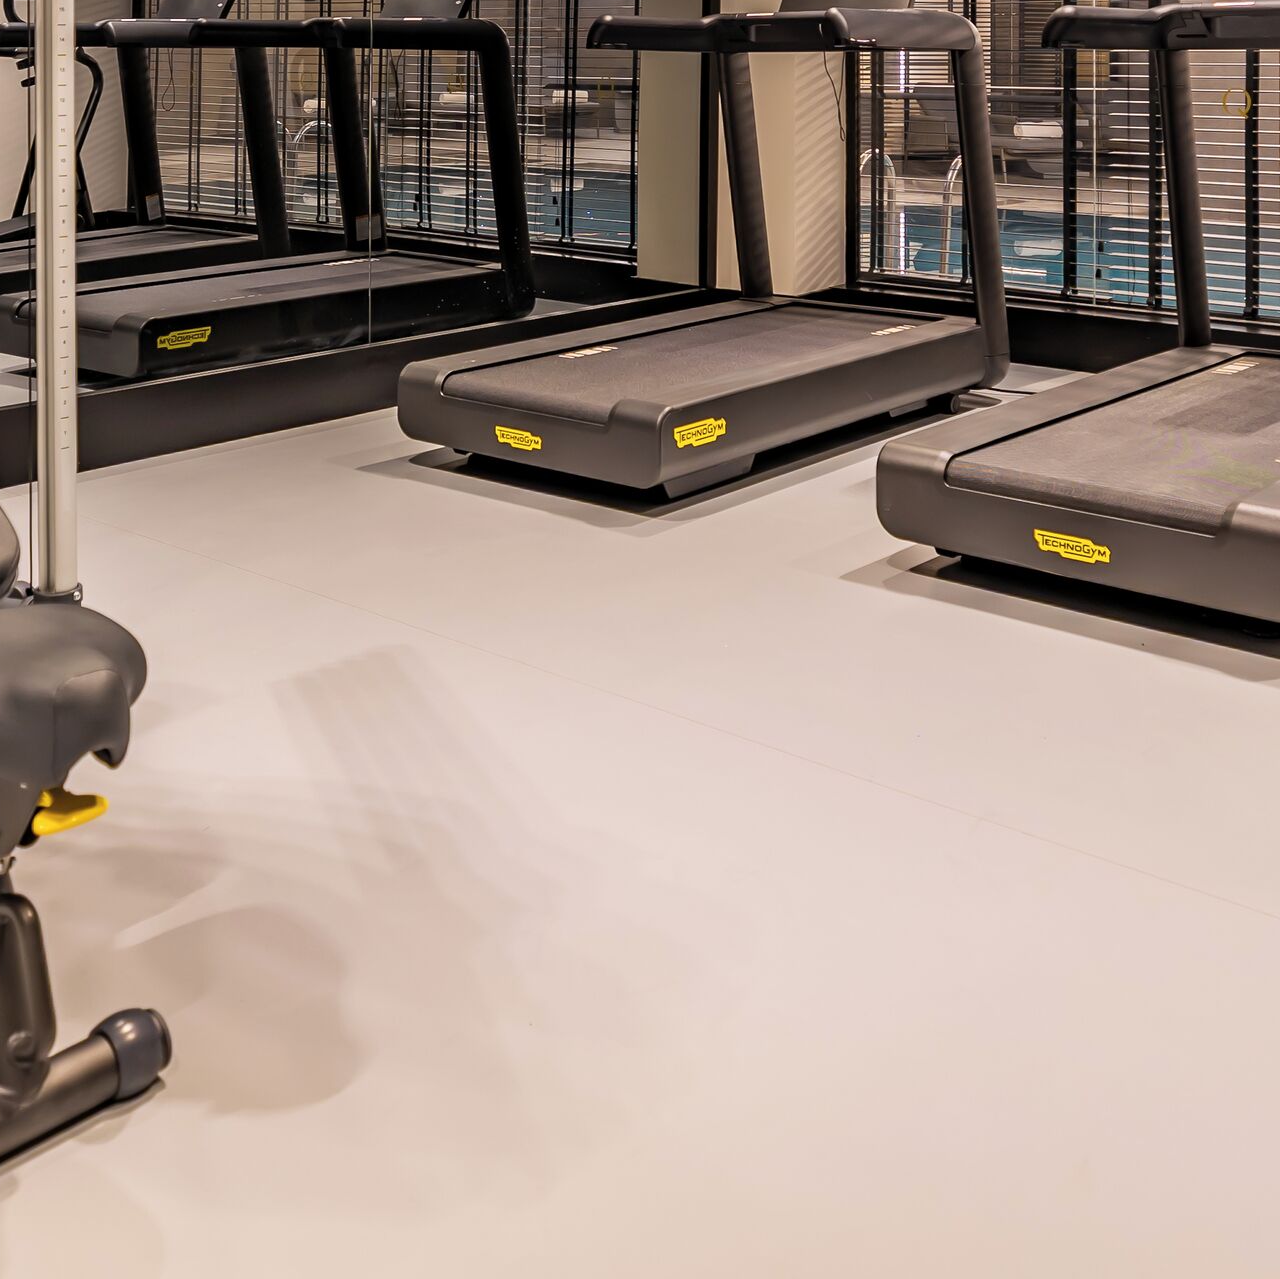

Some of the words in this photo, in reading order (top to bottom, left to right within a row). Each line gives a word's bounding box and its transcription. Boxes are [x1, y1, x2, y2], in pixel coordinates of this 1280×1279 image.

[497, 429, 539, 446] TECHNOGYM
[676, 423, 724, 444] TECHNOGYM
[1037, 533, 1107, 559] TECHNOGYM
